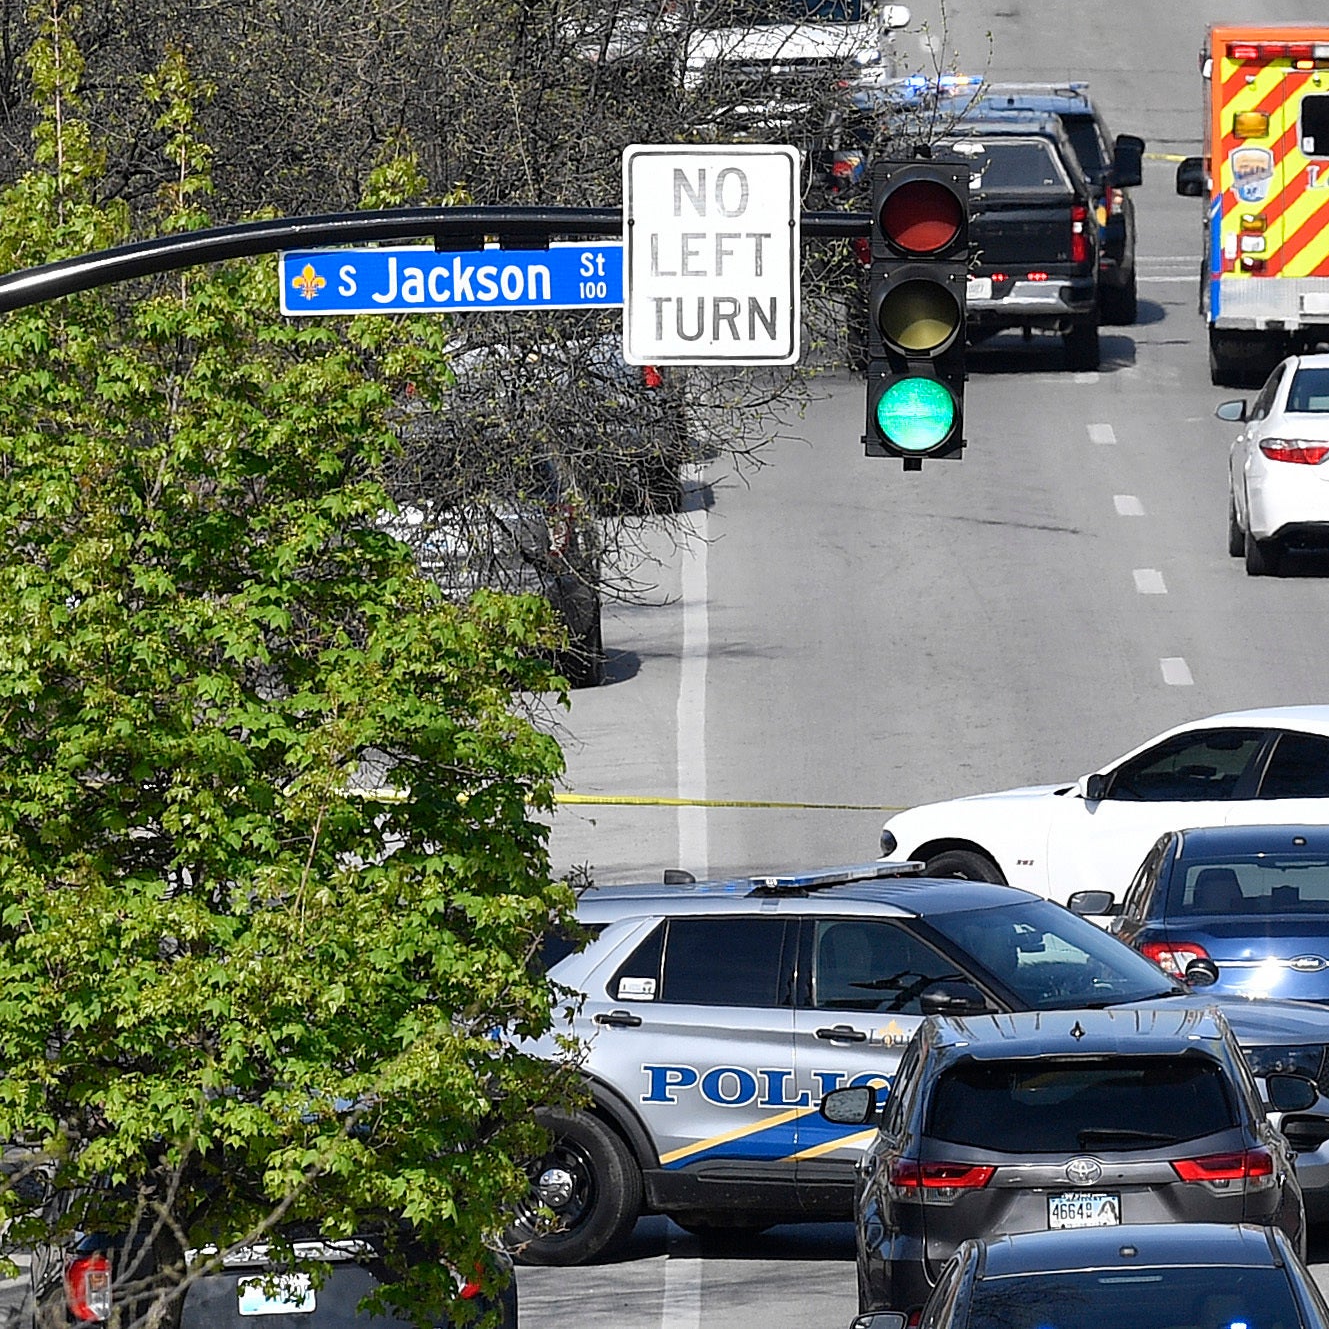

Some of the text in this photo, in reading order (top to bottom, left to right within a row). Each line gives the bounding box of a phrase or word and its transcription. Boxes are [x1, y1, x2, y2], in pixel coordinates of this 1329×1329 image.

[673, 167, 750, 219] NO
[338, 252, 606, 305] S Jackson St
[651, 233, 771, 278] LEFT
[579, 282, 607, 300] 100
[650, 296, 778, 342] TURN
